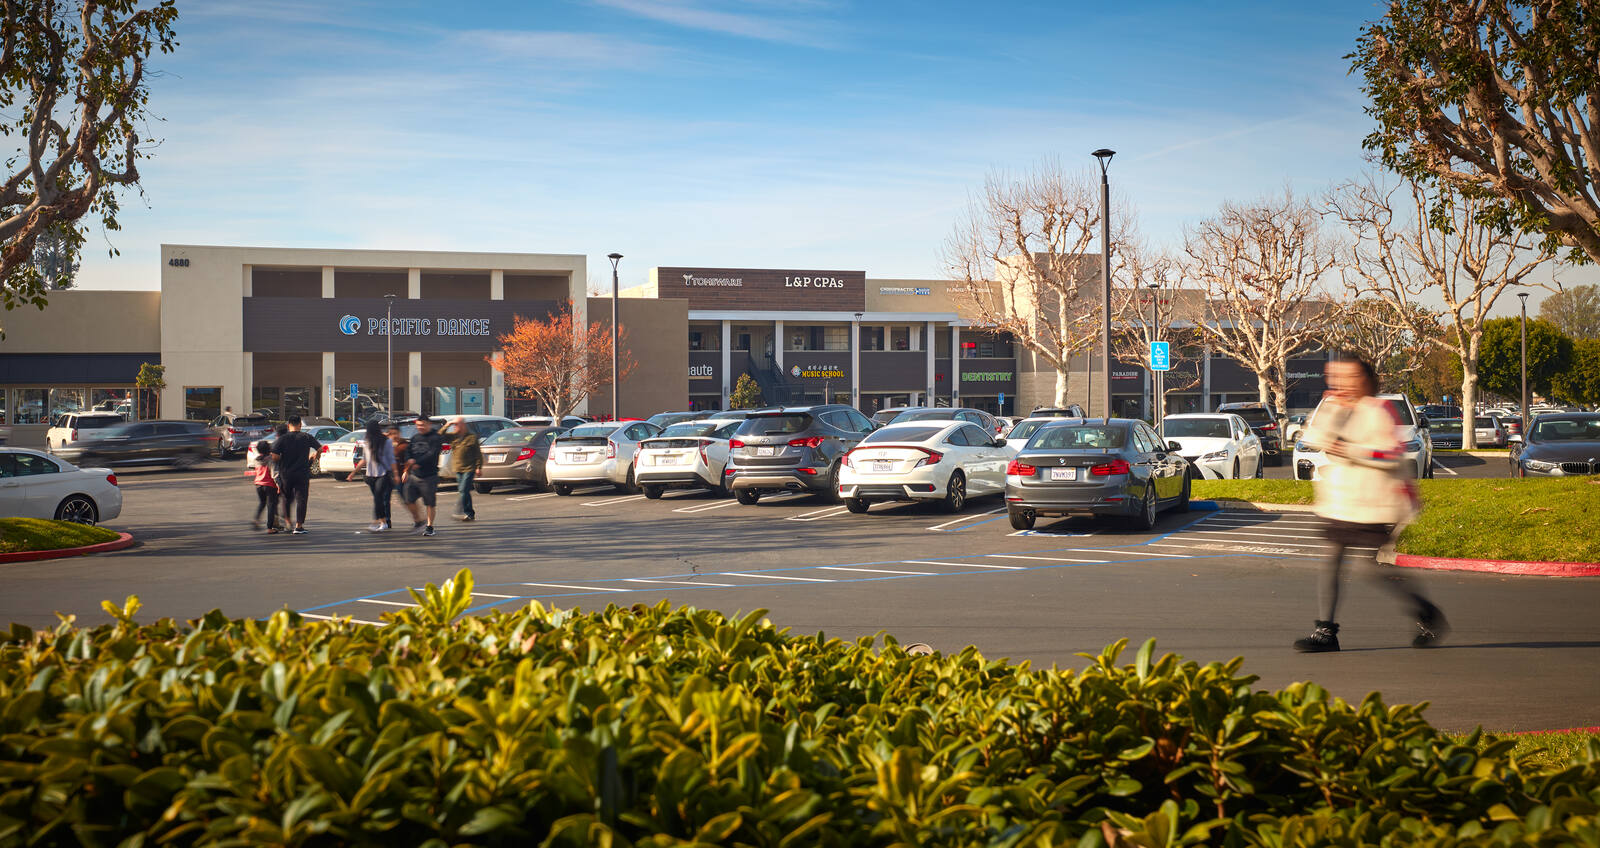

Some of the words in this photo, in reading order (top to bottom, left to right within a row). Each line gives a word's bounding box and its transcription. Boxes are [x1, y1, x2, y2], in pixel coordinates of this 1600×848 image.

[168, 258, 190, 267] 4880
[785, 276, 811, 288] L&P
[813, 277, 844, 288] CPAs
[367, 317, 431, 335] PACIFIC
[436, 318, 490, 336] DANCE
[802, 370, 820, 378] MUSIC
[821, 370, 844, 378] SCHOOL
[962, 372, 1013, 382] DENTISTRY
